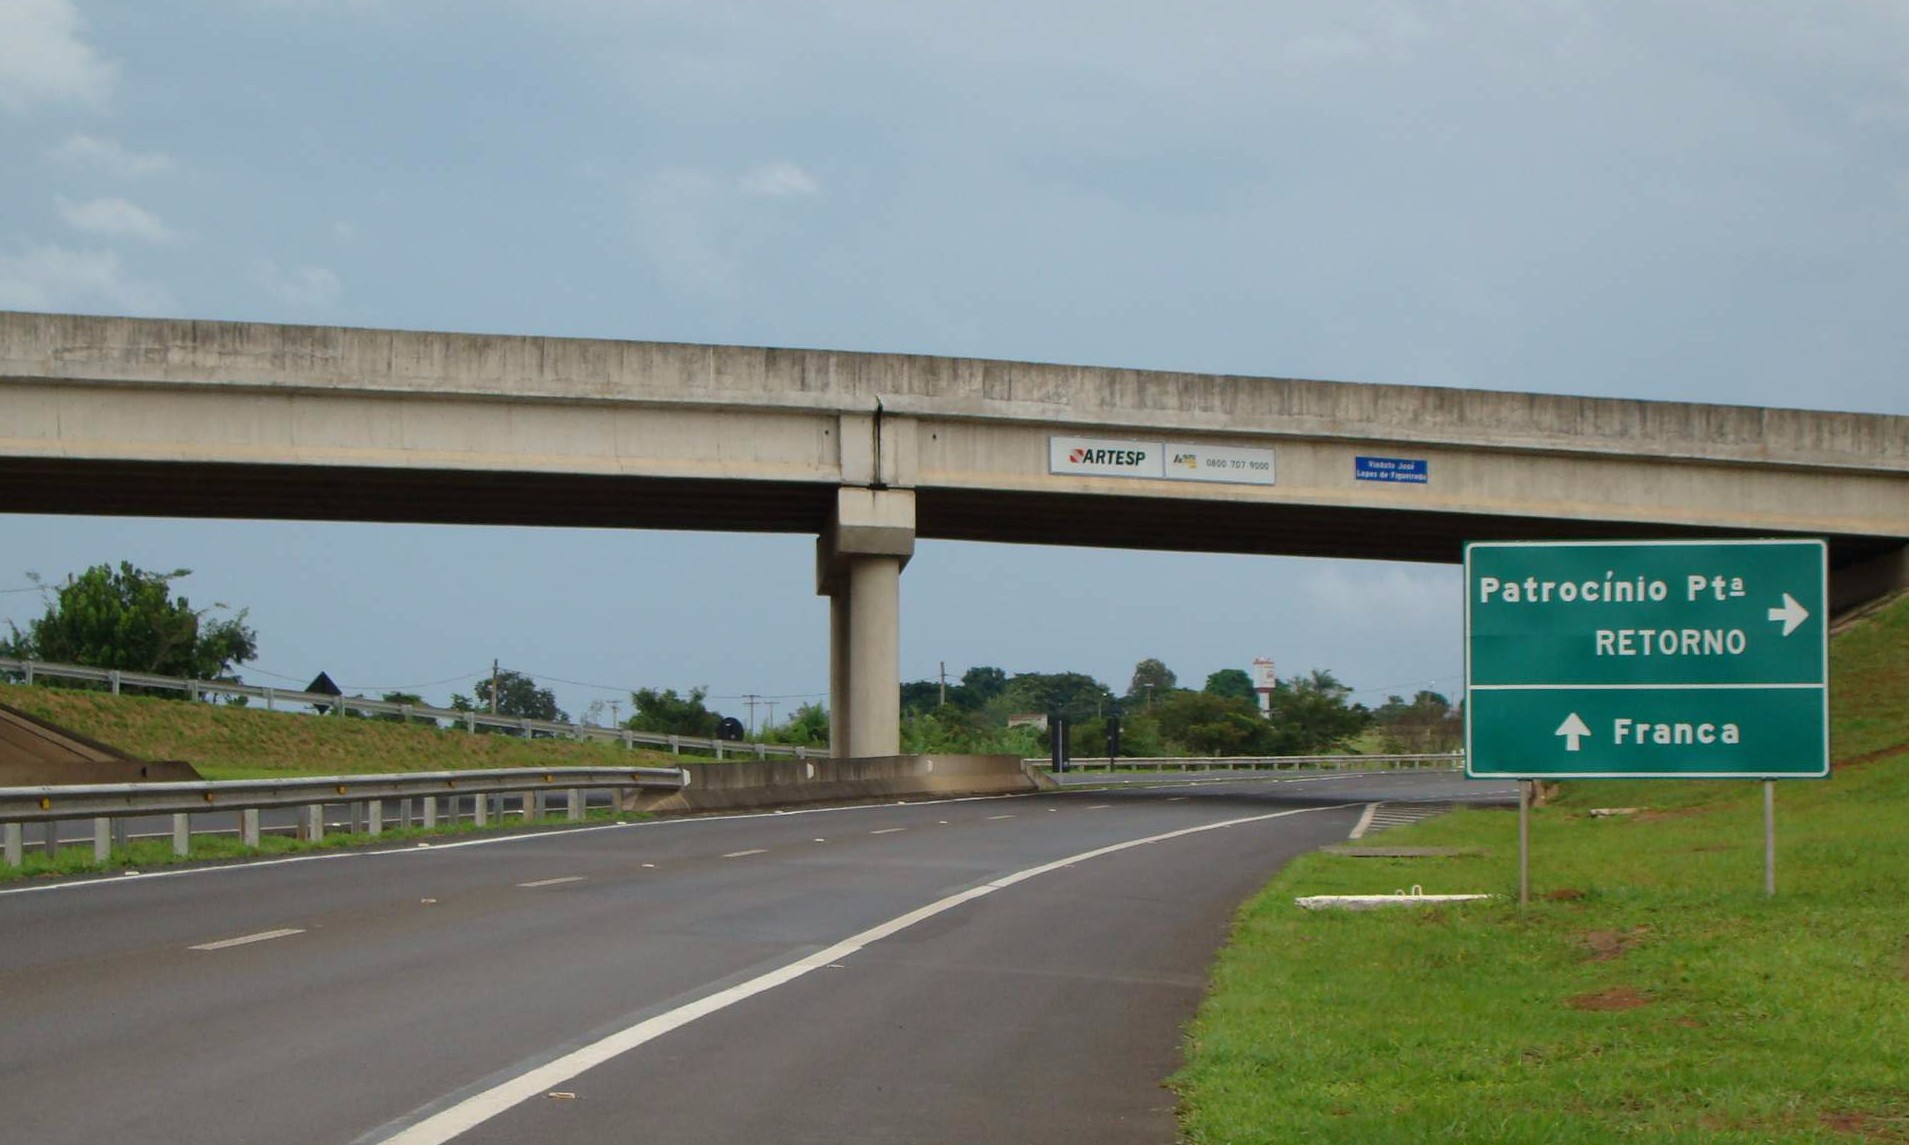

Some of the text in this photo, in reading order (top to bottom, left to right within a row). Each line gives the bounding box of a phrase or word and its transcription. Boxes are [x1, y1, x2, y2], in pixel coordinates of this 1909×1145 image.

[1082, 448, 1146, 466] ARTESP
[1380, 471, 1389, 479] de
[1480, 570, 1668, 603] Patrocínio
[1596, 629, 1747, 656] RETORNO
[1614, 718, 1740, 745] Franca
